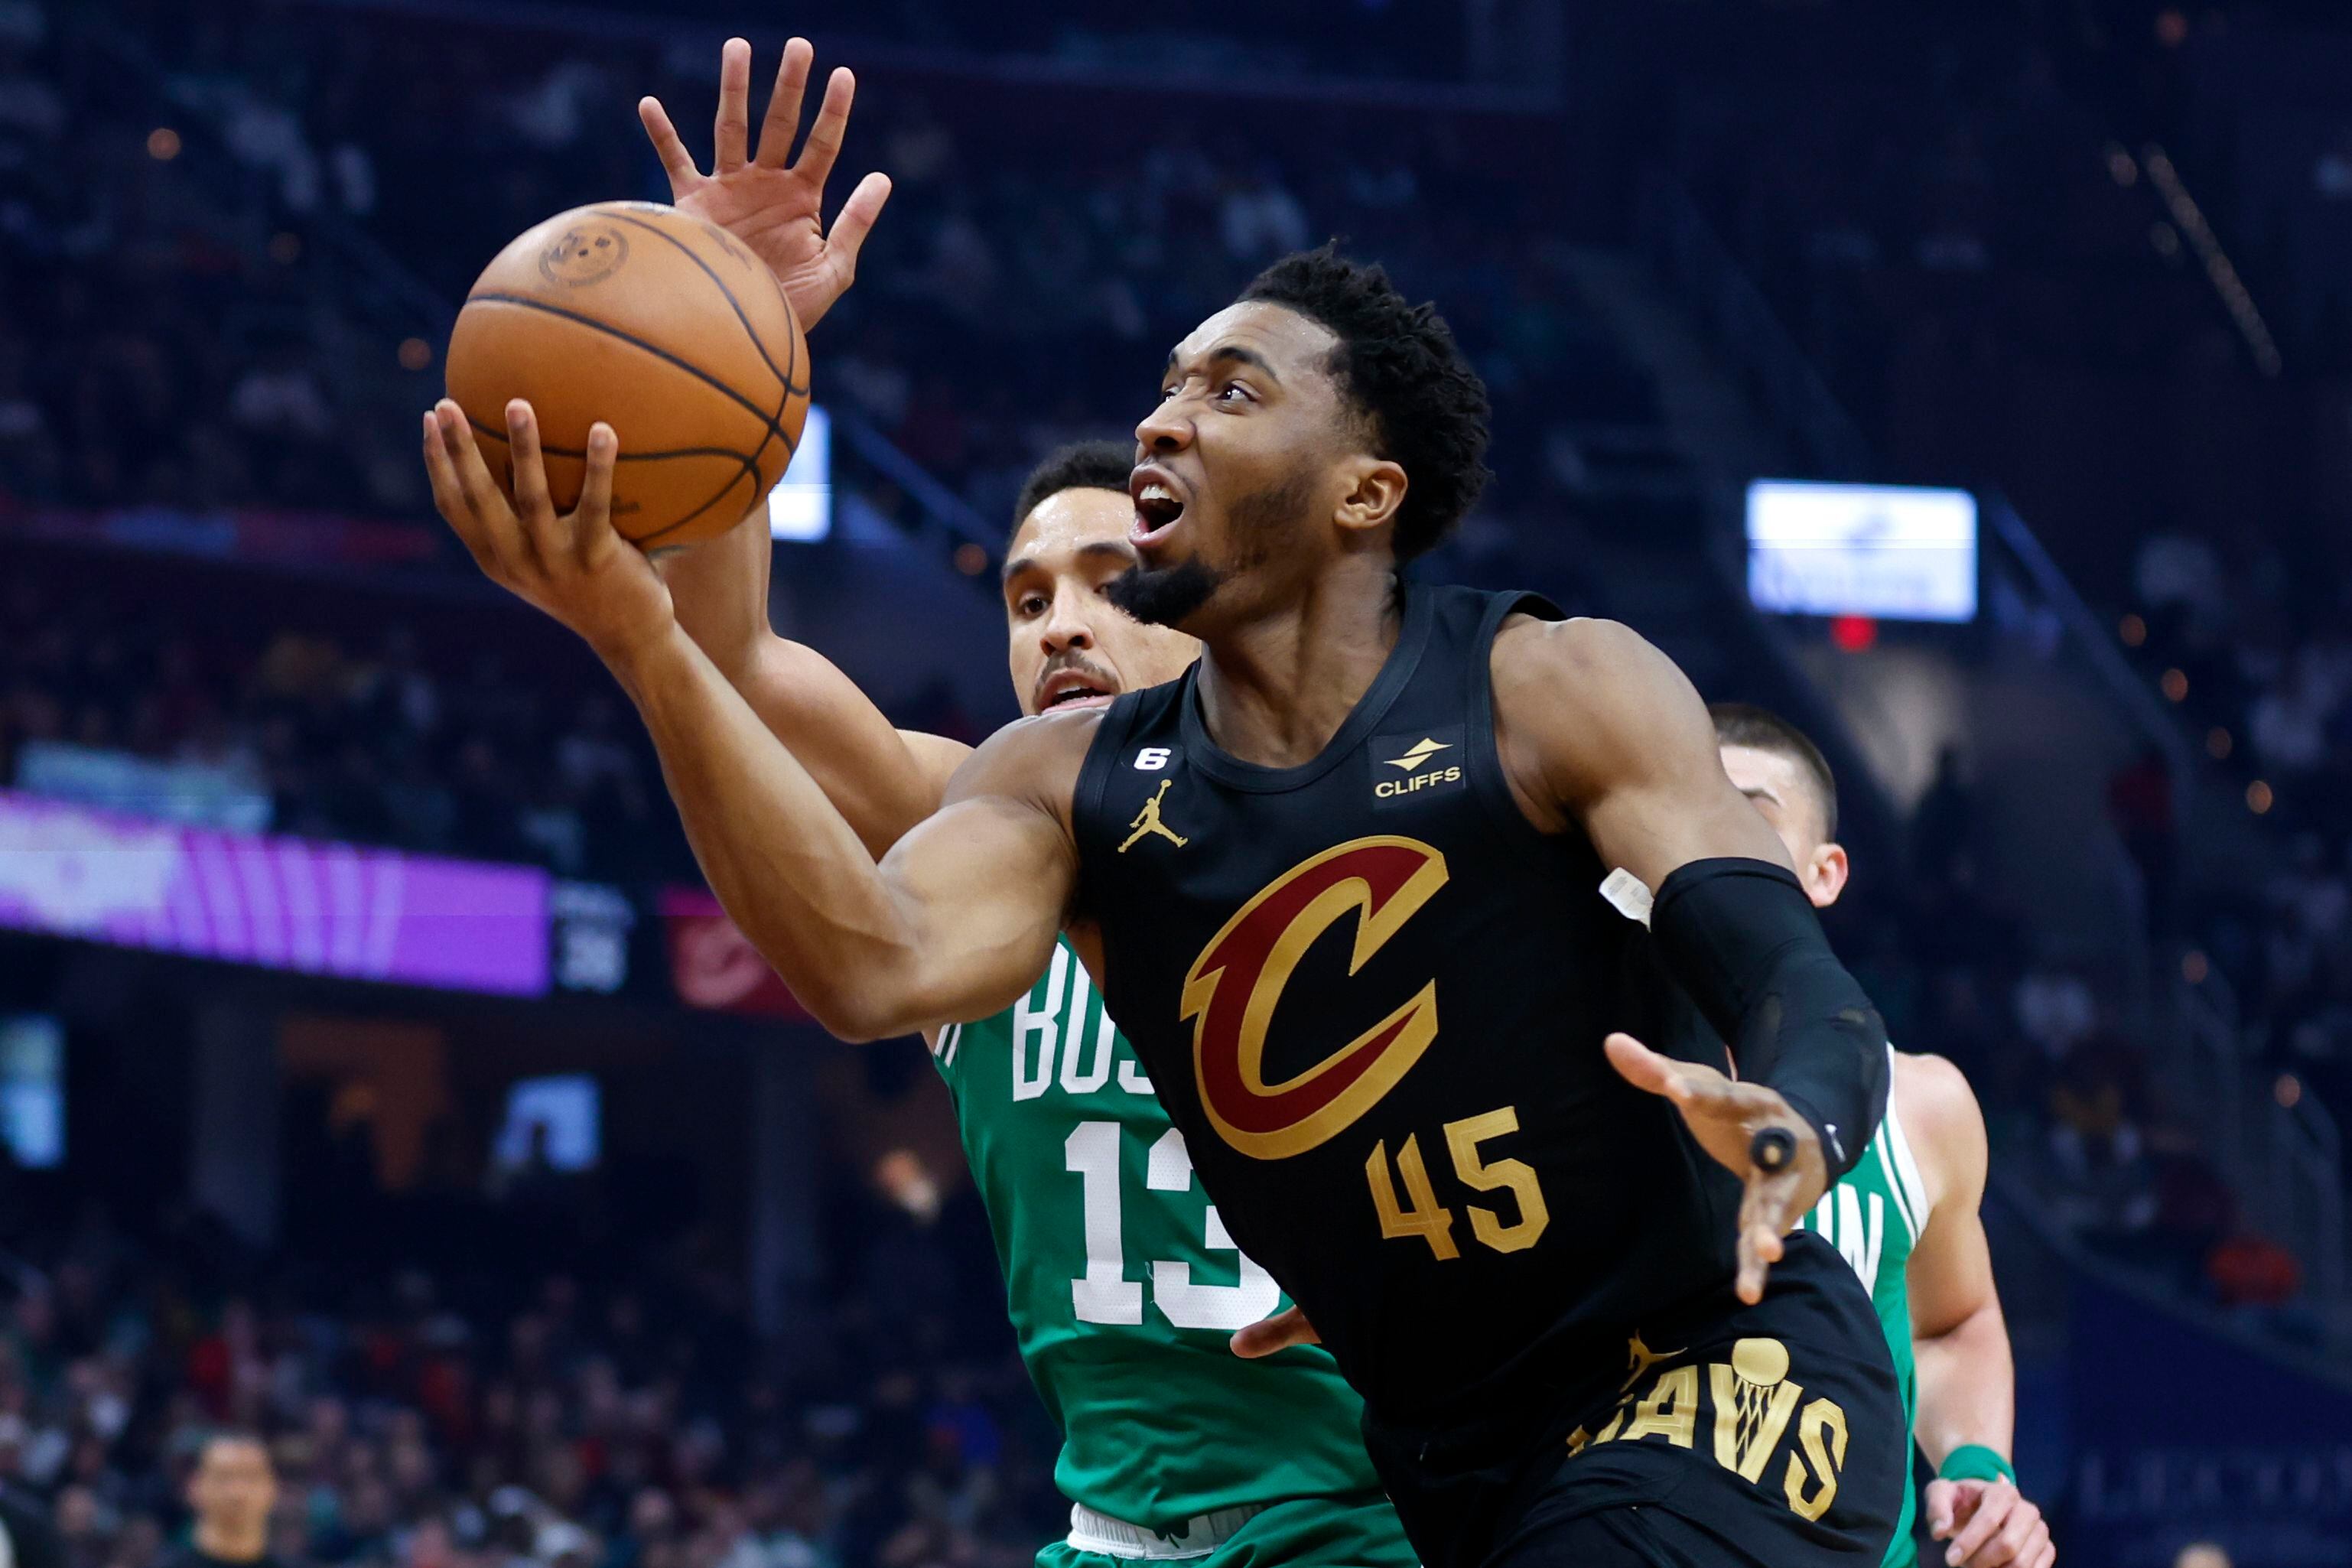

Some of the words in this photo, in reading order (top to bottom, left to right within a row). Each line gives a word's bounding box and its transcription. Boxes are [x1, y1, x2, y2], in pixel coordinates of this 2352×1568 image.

[1134, 747, 1172, 770] 6
[1374, 766, 1461, 798] CLIFFS
[1179, 834, 1449, 1160] C
[1065, 1121, 1280, 1329] 13
[1365, 1106, 1550, 1261] 45
